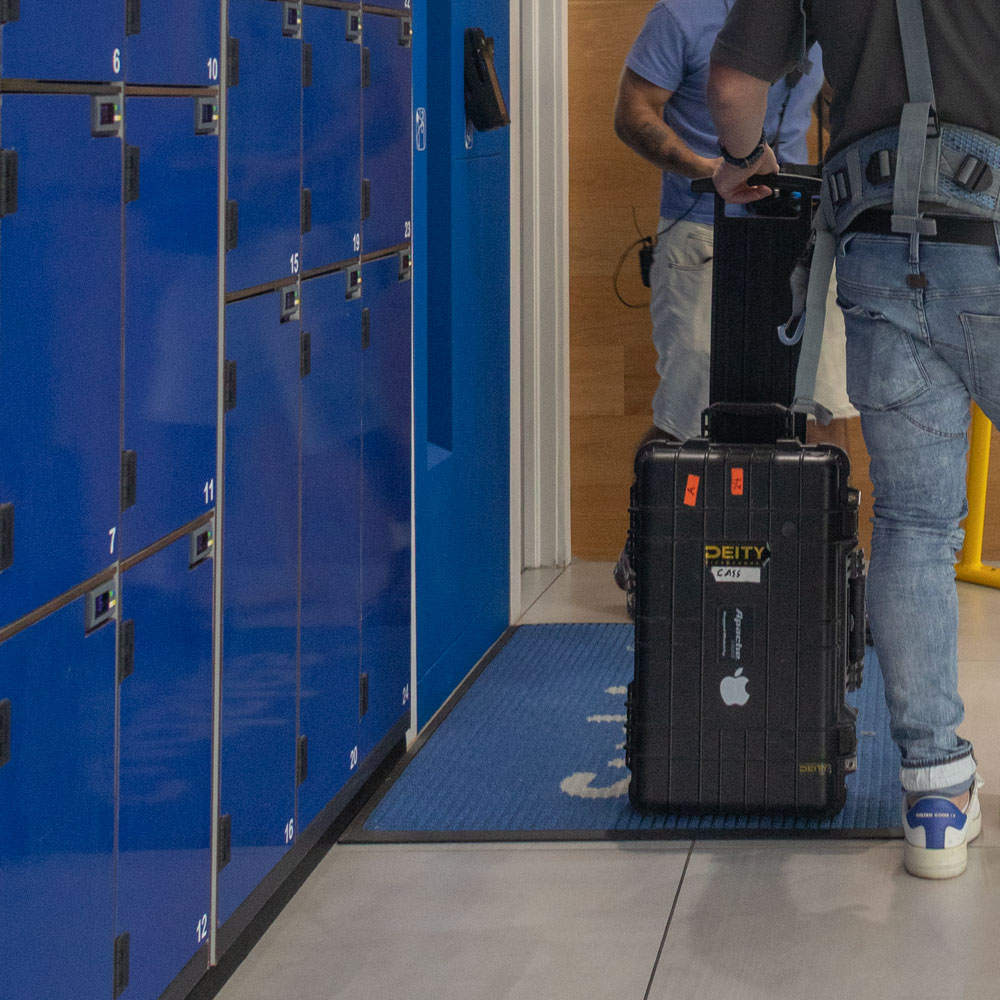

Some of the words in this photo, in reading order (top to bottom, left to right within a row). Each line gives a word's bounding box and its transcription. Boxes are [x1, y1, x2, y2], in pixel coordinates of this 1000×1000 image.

[112, 48, 121, 74] 6
[207, 58, 218, 81] 10
[352, 234, 361, 252] 19
[290, 253, 299, 274] 15
[203, 479, 214, 505] 11
[108, 527, 116, 555] 7
[705, 545, 765, 560] DEITY
[717, 568, 741, 578] CASS
[733, 607, 744, 661] Apache
[349, 746, 358, 770] 20
[284, 818, 294, 844] 16
[196, 914, 208, 943] 12
